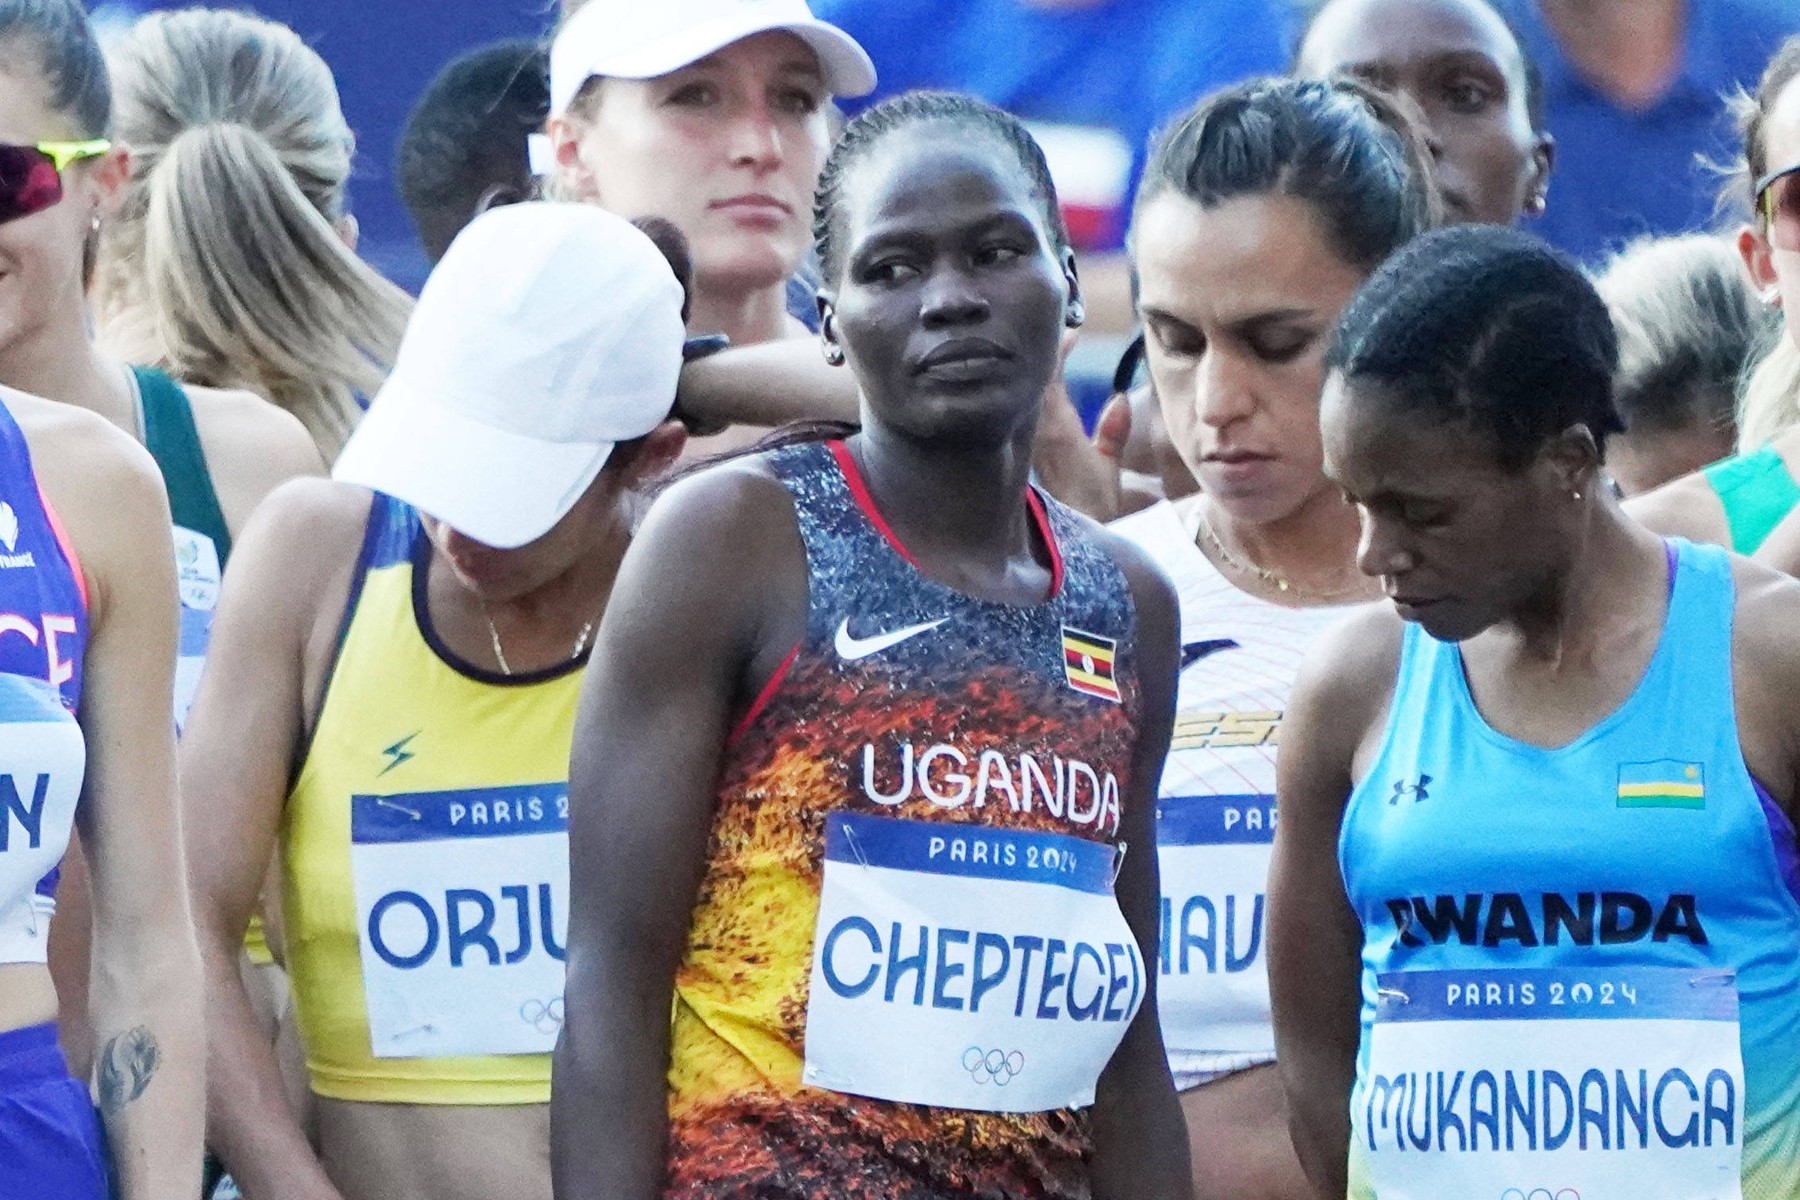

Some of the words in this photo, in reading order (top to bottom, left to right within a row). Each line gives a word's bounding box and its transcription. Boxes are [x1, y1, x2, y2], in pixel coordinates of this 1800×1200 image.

[450, 796, 544, 826] PARIS
[863, 743, 1120, 837] UGANDA
[929, 836, 1017, 867] PARIS
[1026, 845, 1078, 874] 2024
[821, 915, 1142, 1022] CHEPTEGEI
[1446, 982, 1536, 1006] PARIS
[1549, 982, 1638, 1005] 2024
[1366, 1067, 1736, 1152] MUKANDANGA
